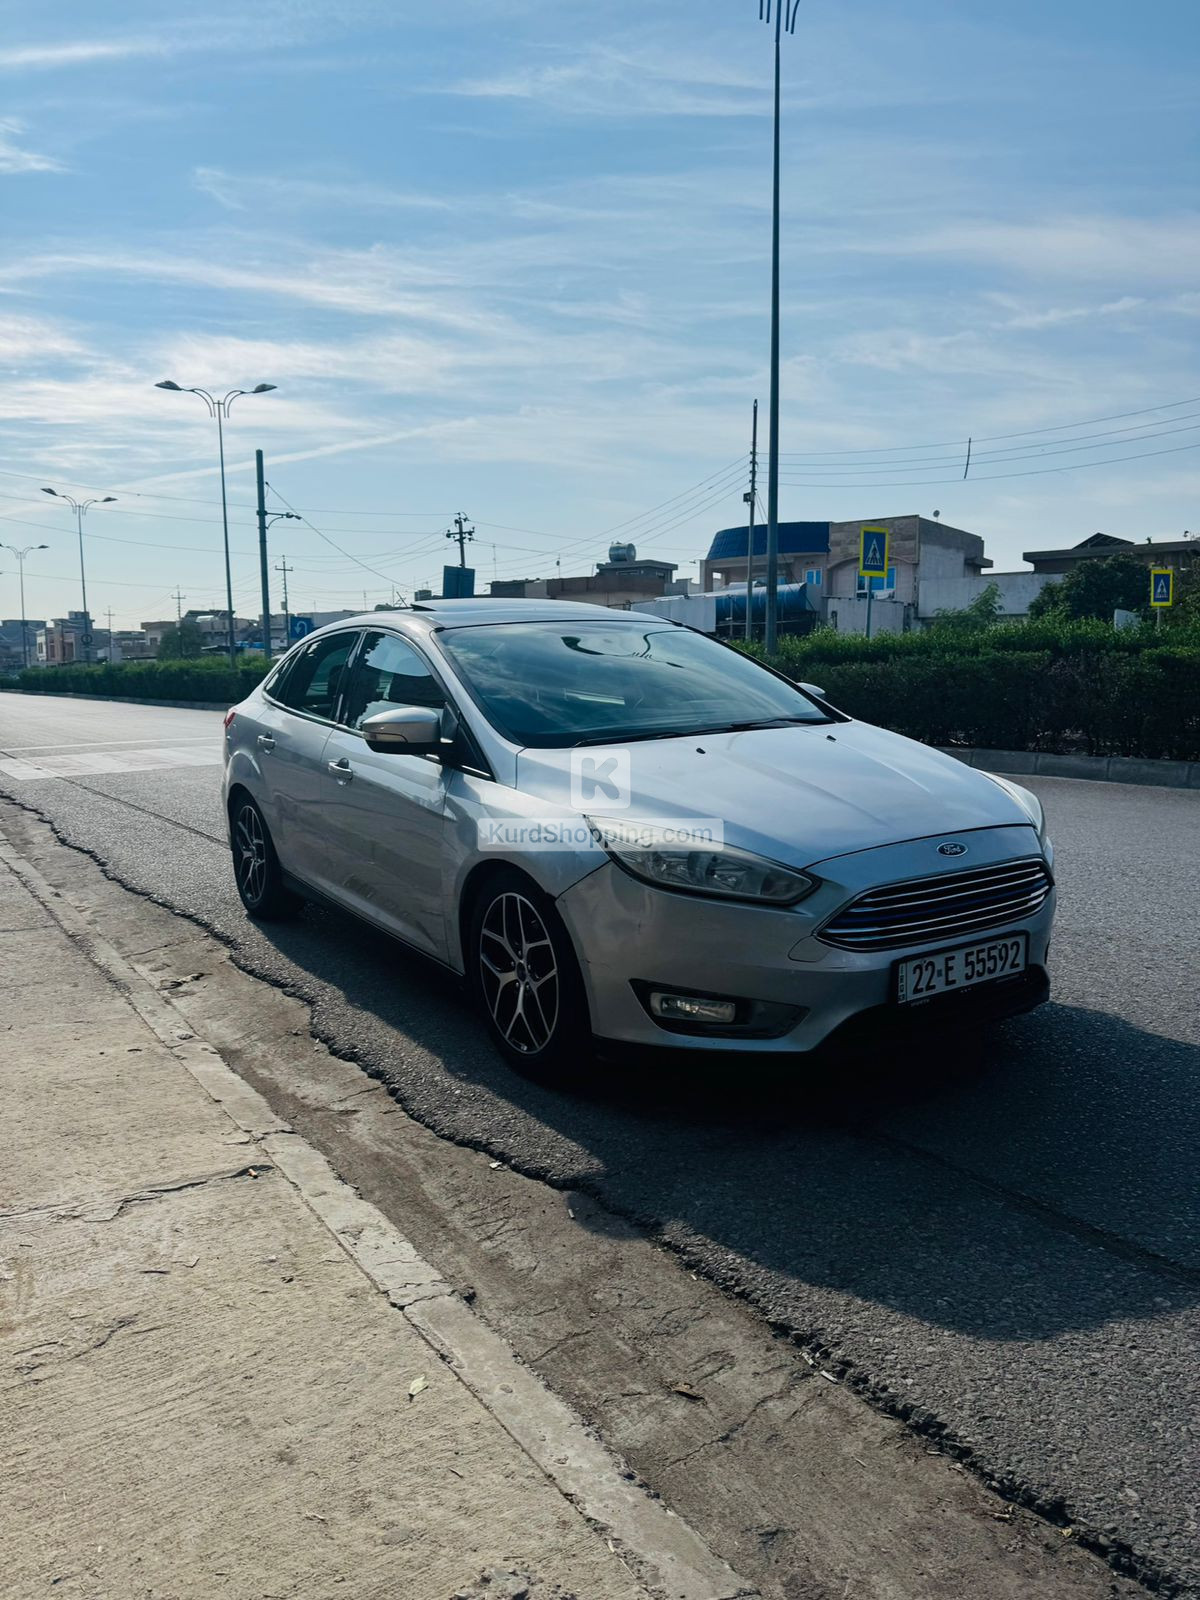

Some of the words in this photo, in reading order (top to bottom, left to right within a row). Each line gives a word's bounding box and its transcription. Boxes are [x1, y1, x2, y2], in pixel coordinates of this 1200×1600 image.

[912, 960, 936, 995] 22
[944, 956, 956, 986] E
[964, 940, 1021, 981] 55592
